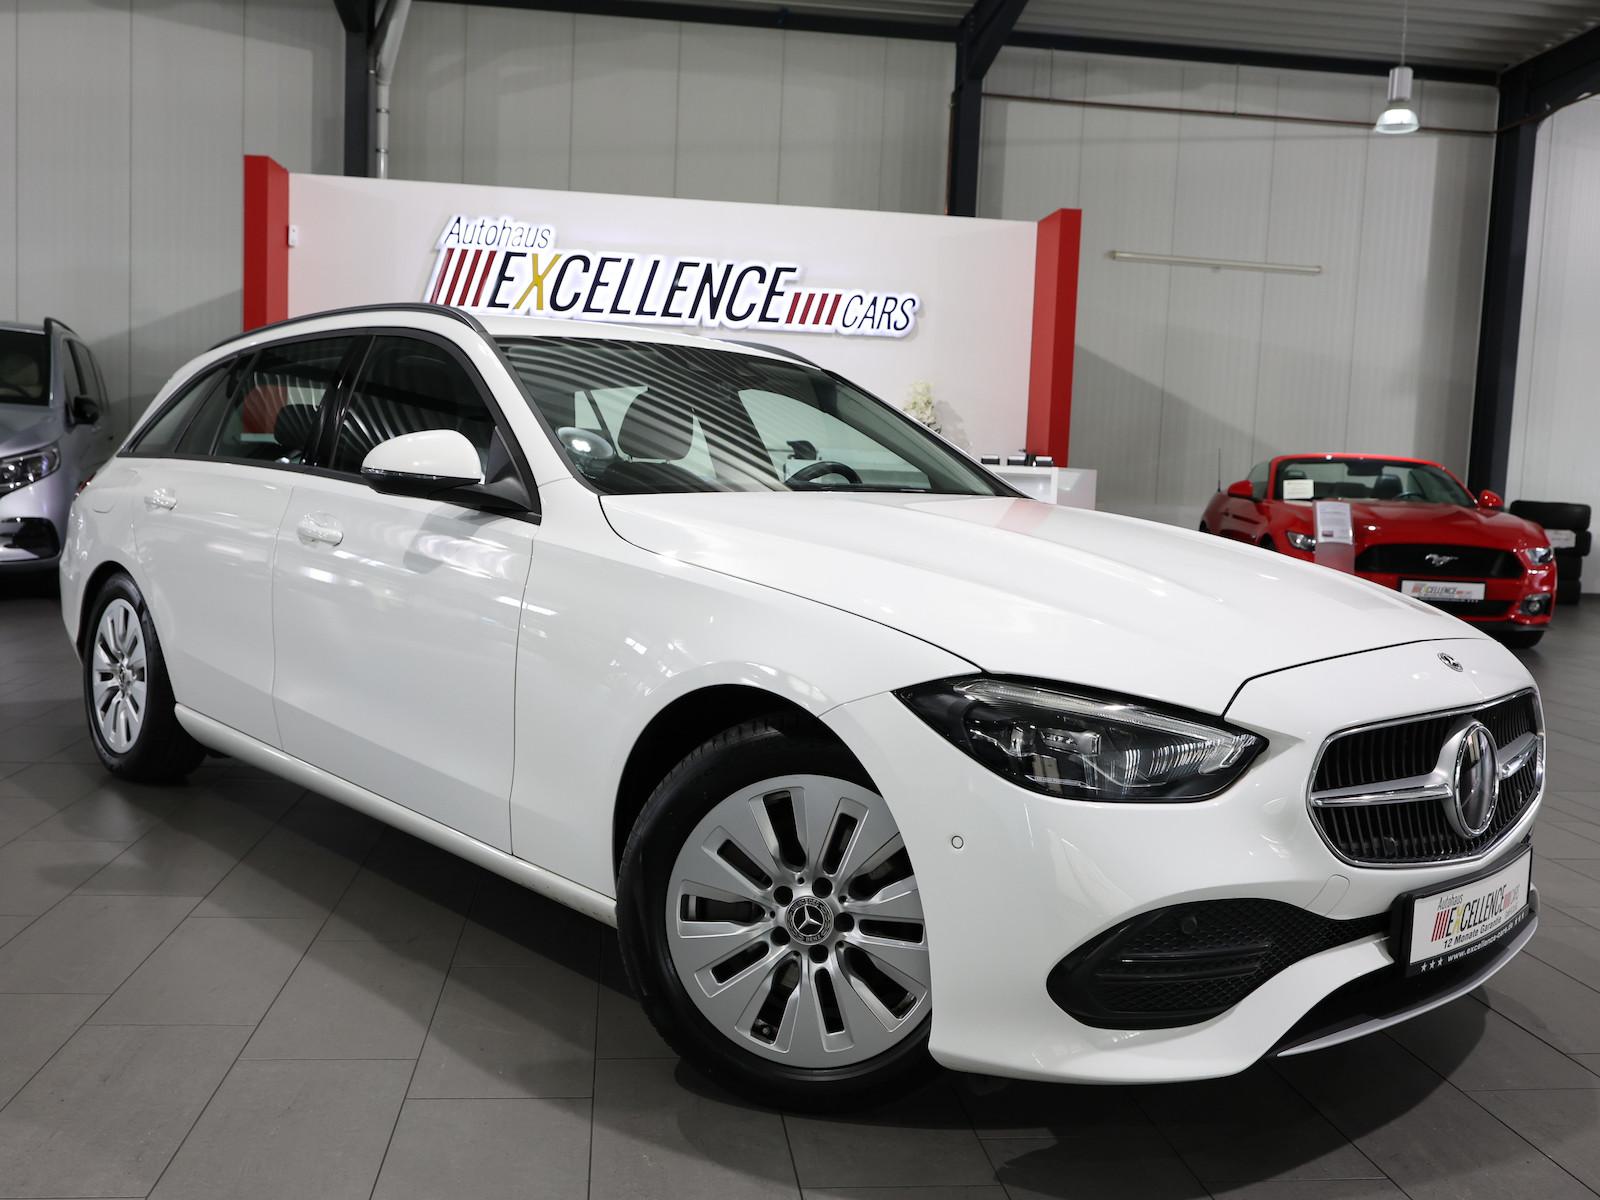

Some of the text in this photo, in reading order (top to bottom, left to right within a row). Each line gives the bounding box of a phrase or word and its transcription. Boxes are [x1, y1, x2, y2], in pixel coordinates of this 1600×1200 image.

[444, 216, 551, 249] Autohaus
[487, 251, 917, 331] EXCELLENCE CARS
[1437, 894, 1464, 911] Autohaus
[1445, 884, 1507, 938] EXCELLENCE
[1443, 938, 1453, 949] 12
[1454, 928, 1479, 945] Monate
